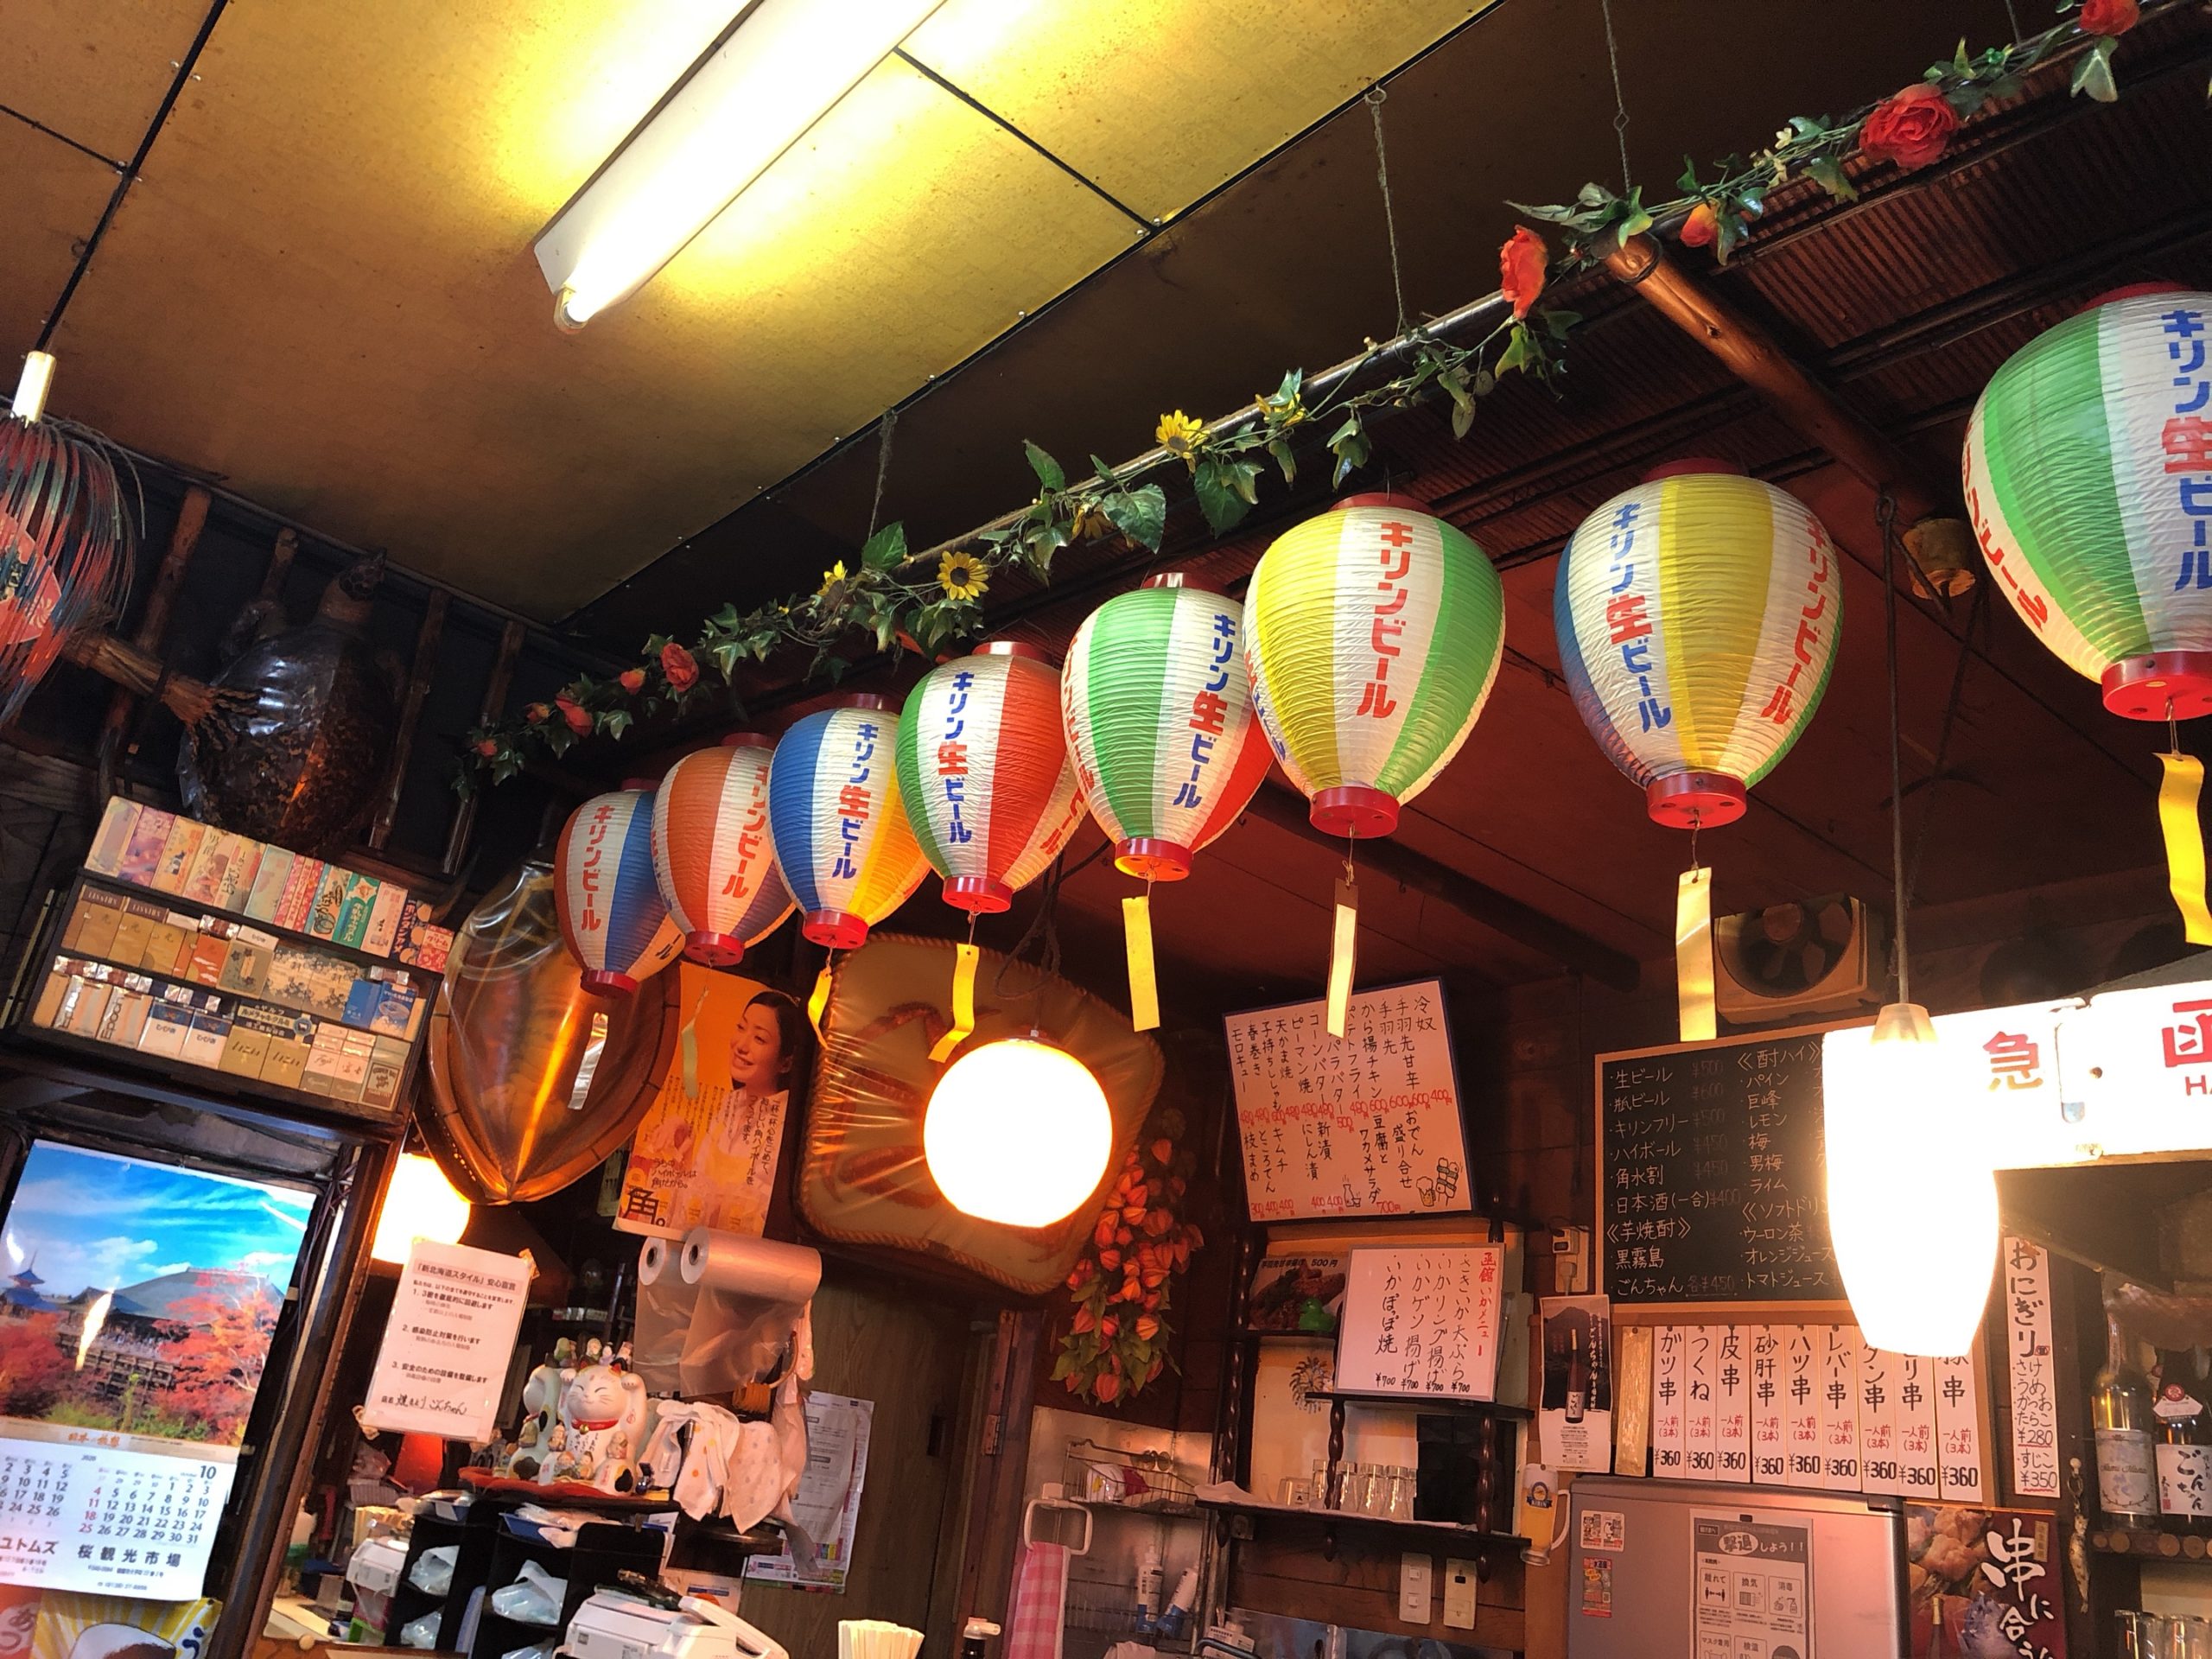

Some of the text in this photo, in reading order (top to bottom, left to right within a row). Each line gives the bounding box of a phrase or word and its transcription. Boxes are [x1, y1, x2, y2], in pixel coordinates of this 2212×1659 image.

[2160, 308, 2212, 593] キリン生ビール
[1356, 521, 1414, 719] キリンビール
[1605, 501, 1672, 733] キリン生ビール
[1760, 513, 1832, 726] キリンビール
[1173, 613, 1242, 810] キリン生ビール
[937, 671, 976, 845] キリン生ビール
[831, 722, 880, 880] キリン生ビール
[721, 766, 769, 899] キリンビール
[581, 804, 616, 932] キリンビール
[1413, 995, 1438, 1032] 冷奴
[1378, 999, 1398, 1056] 手羽先
[1247, 1024, 1262, 1077] 春巻き
[1275, 1019, 1294, 1079] 天かま焼
[1292, 1017, 1313, 1094] ピーマン焼
[1360, 1002, 1382, 1098] から揚チキン
[1395, 997, 1420, 1090] 手羽先甘辛
[1231, 1028, 1249, 1093] モロキュー
[1261, 1020, 1281, 1112] 子持ちししゃも
[1310, 1014, 1327, 1105] コーンバター
[1982, 1031, 2044, 1091] 急
[1614, 1066, 1674, 1090] 生ビール
[1745, 1072, 1789, 1089] パイン
[1612, 1090, 1671, 1114] 瓶ビール
[1746, 1089, 1782, 1109] 巨峰
[1406, 1109, 1424, 1157] おでん
[1614, 1113, 1689, 1139] キリンフリー
[1750, 1111, 1788, 1129] レモン
[746, 1096, 771, 1185] おいしい角ハイボールを
[1273, 1128, 1288, 1173] キムチ
[1302, 1123, 1319, 1181] にしん漬
[1316, 1121, 1332, 1161] 新漬
[1373, 1114, 1389, 1164] 豆腐と
[1613, 1140, 1682, 1162] ハイボール
[1748, 1132, 1771, 1151] 梅
[1243, 1133, 1260, 1182] 枝まめ
[1259, 1130, 1276, 1193] ところてん
[1359, 1128, 1382, 1205] ワカメサラダ
[1392, 1123, 1413, 1189] 盛り合せ
[1749, 1154, 1784, 1173] 男梅
[1615, 1164, 1664, 1190] 角水割
[1749, 1177, 1789, 1195] ライム
[1616, 1189, 1710, 1214] 日本酒(一合)
[1743, 1223, 1804, 1244] ウーロン茶
[1615, 1244, 1665, 1270] 黒霧島
[1745, 1244, 1837, 1265] オレンジジュース
[1617, 1277, 1684, 1297] ごんちゃん
[1746, 1270, 1829, 1290] トマトジュース
[1375, 1260, 1402, 1356] いかぽっぽ焼
[2009, 1241, 2044, 1358] おにぎり
[1403, 1256, 1431, 1379] いかゲソ揚げ
[1426, 1256, 1452, 1383] いかリング揚げ
[1448, 1256, 1471, 1382] さきいか天ぷら
[1658, 1332, 1682, 1407] ガツ串
[1689, 1336, 1711, 1402] つくね
[1719, 1331, 1742, 1397] 皮串
[1753, 1334, 1779, 1408] 砂肝串
[1789, 1335, 1811, 1406] ハツ串
[1826, 1332, 1852, 1410] レバー串
[2016, 1357, 2043, 1377] さけ
[1375, 1372, 1396, 1388] ¥700
[1401, 1377, 1420, 1390] ¥700
[1426, 1381, 1445, 1393] ¥700
[1451, 1382, 1471, 1393] ¥700
[1901, 1353, 1923, 1412] り串
[2017, 1378, 2047, 1396] うめ
[1790, 1415, 1815, 1429] 一人前
[1827, 1419, 1853, 1433] 一人前
[1864, 1424, 1891, 1438] 一人前
[1901, 1424, 1929, 1440] 一人前
[2018, 1411, 2052, 1427] たらこ
[1942, 1427, 1972, 1444] 一人前
[2018, 1427, 2053, 1446] ¥280
[1654, 1448, 1681, 1467] ¥360
[1686, 1450, 1714, 1470] ¥360
[1717, 1449, 1746, 1469] ¥360
[1754, 1455, 1784, 1476] ¥360
[1788, 1452, 1821, 1474] ¥360
[1824, 1458, 1857, 1477] ¥360
[1863, 1459, 1897, 1480] ¥360
[2021, 1448, 2055, 1469] すじこ
[200, 1465, 217, 1480] 10
[1898, 1465, 1936, 1485] ¥360
[1942, 1465, 1979, 1487] ¥360
[2020, 1471, 2058, 1489] ¥350
[79, 1522, 199, 1544] 25 26 27 28 29 30 31
[78, 1543, 181, 1568] 桜観光市場
[1704, 1573, 1726, 1585] 離れて
[1741, 1577, 1758, 1588] 換気
